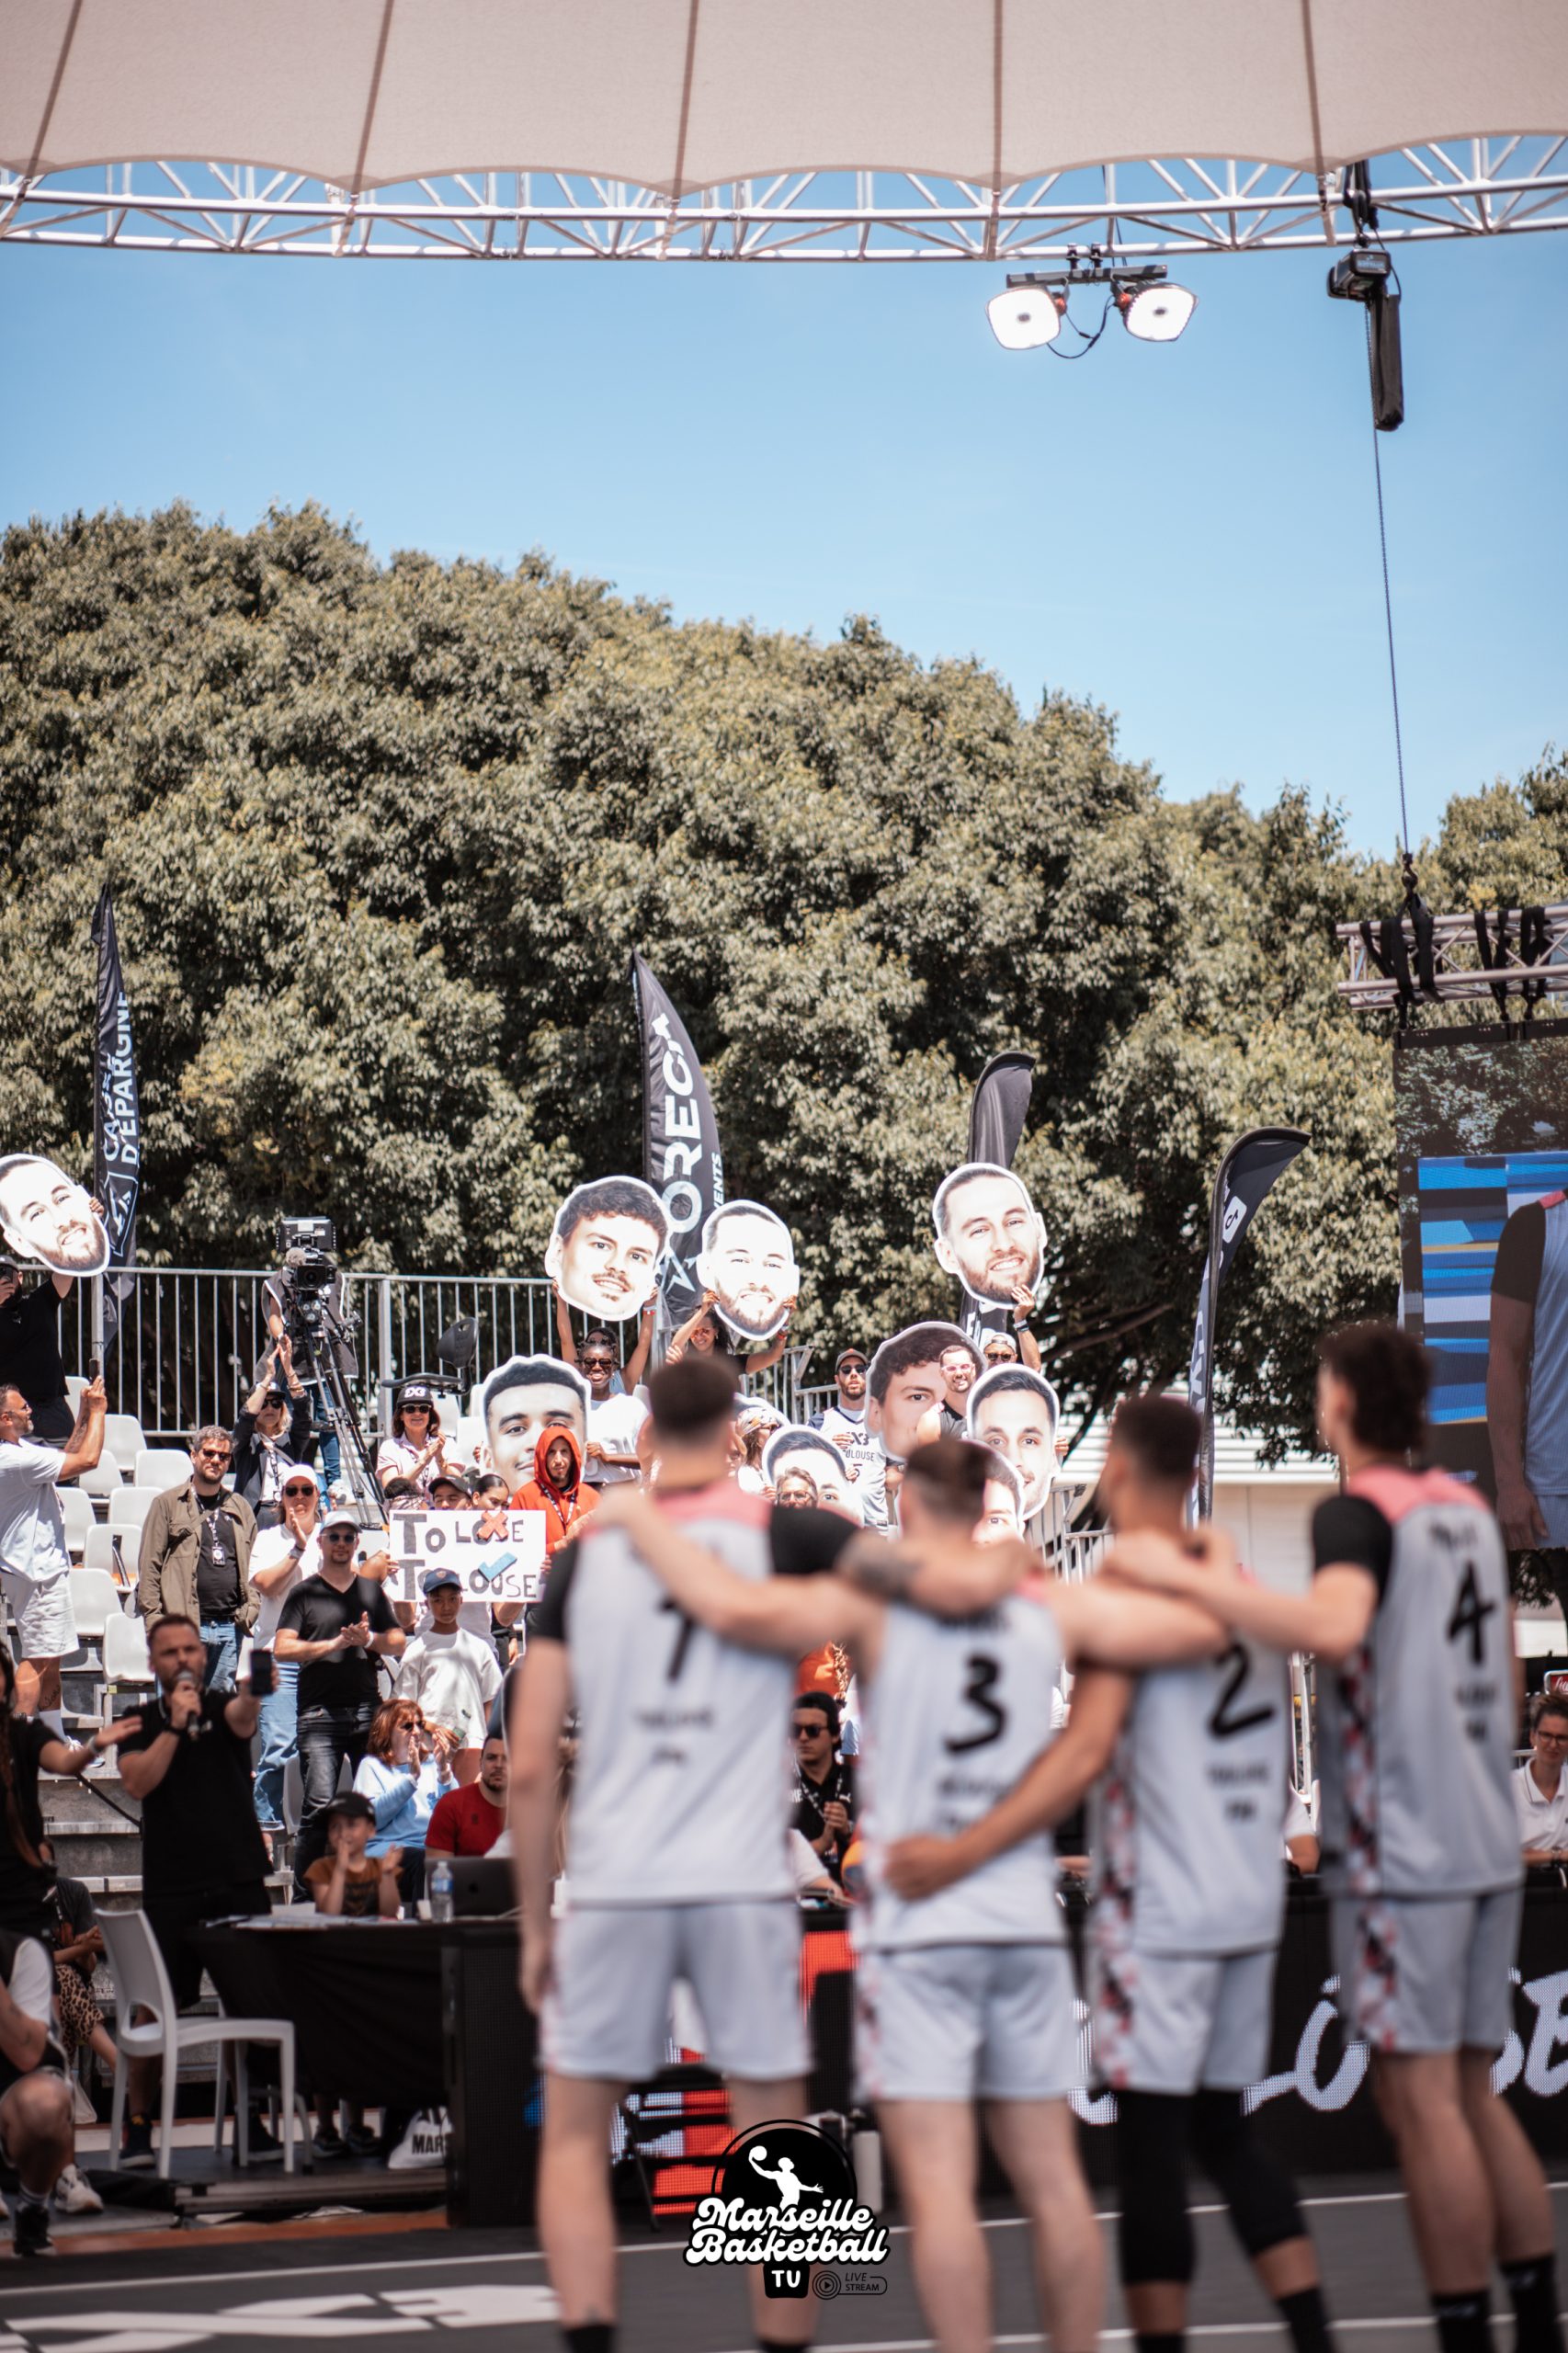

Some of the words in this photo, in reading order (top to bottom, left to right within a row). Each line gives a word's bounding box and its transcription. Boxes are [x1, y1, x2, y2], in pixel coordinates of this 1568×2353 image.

[1446, 1558, 1495, 1666] 4
[945, 1655, 1007, 1755] 3
[1207, 1642, 1276, 1739] 2
